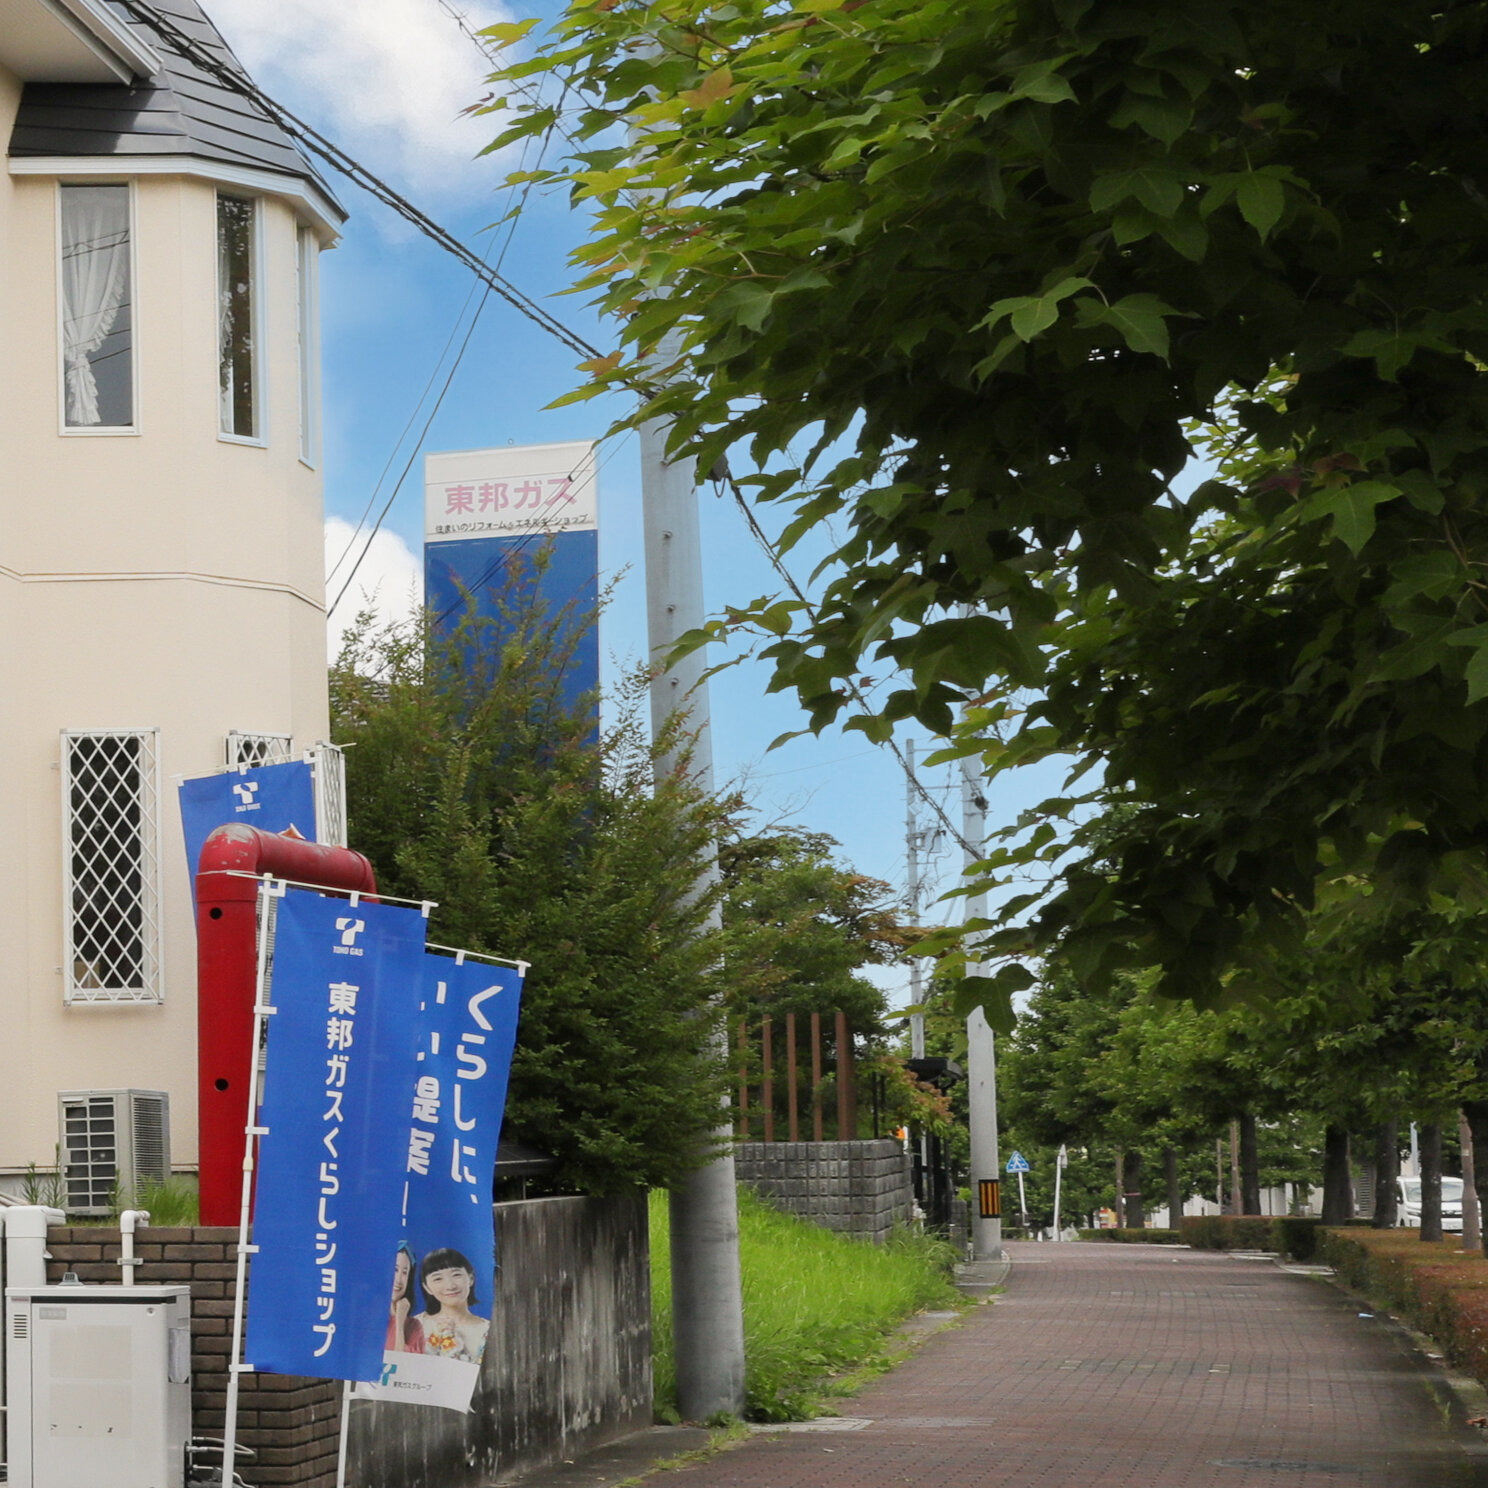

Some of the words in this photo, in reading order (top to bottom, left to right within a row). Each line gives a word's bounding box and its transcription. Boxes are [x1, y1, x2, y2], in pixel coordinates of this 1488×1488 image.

[444, 478, 577, 516] 東邦ガス
[312, 981, 360, 1359] 東邦ガスくらしショップ
[451, 985, 504, 1205] くらしに、
